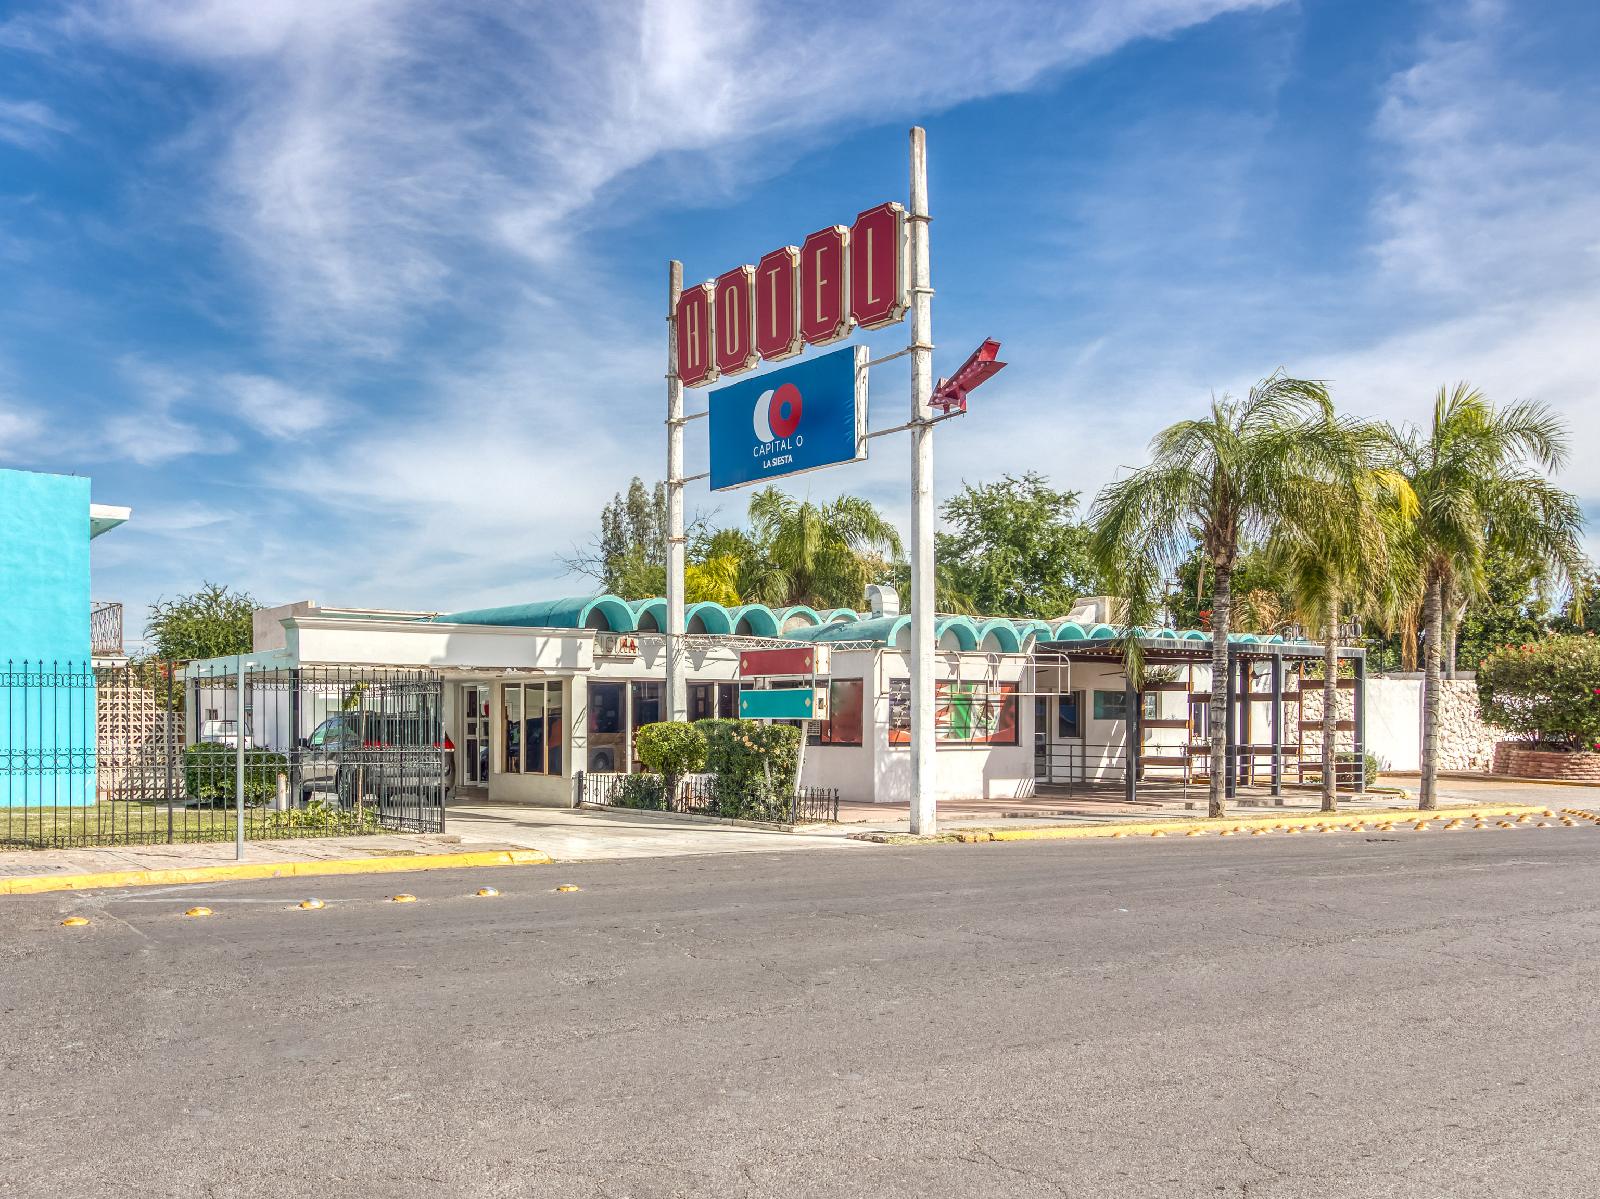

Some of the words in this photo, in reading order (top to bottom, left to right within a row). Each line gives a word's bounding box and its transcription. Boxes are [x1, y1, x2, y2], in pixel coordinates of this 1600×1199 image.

[686, 228, 881, 370] HOTEL
[753, 438, 792, 457] CAPITAL
[796, 435, 803, 447] O
[763, 460, 771, 469] LA
[772, 454, 793, 467] SIESTA
